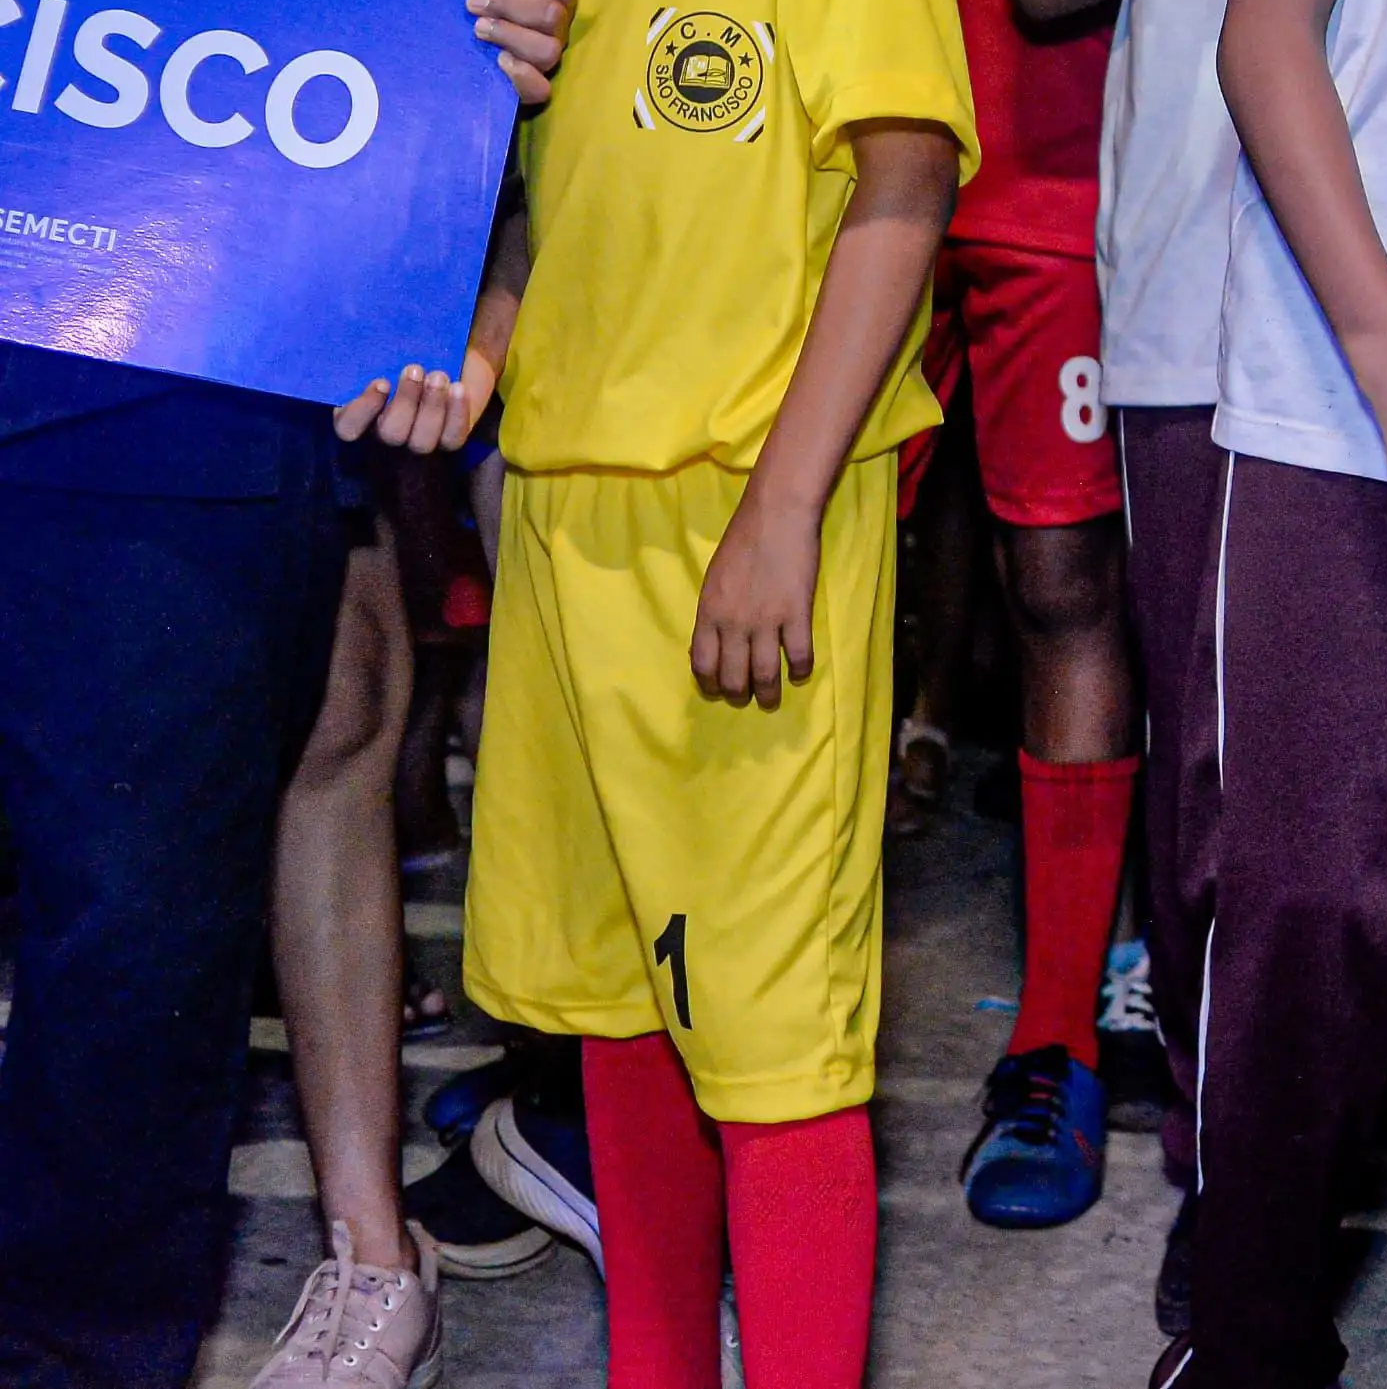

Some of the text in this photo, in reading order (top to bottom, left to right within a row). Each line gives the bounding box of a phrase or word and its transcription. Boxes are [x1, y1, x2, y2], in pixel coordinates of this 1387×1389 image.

[668, 76, 753, 122] FRANCISCO
[1059, 355, 1107, 443] 8
[653, 914, 692, 1030] 1
